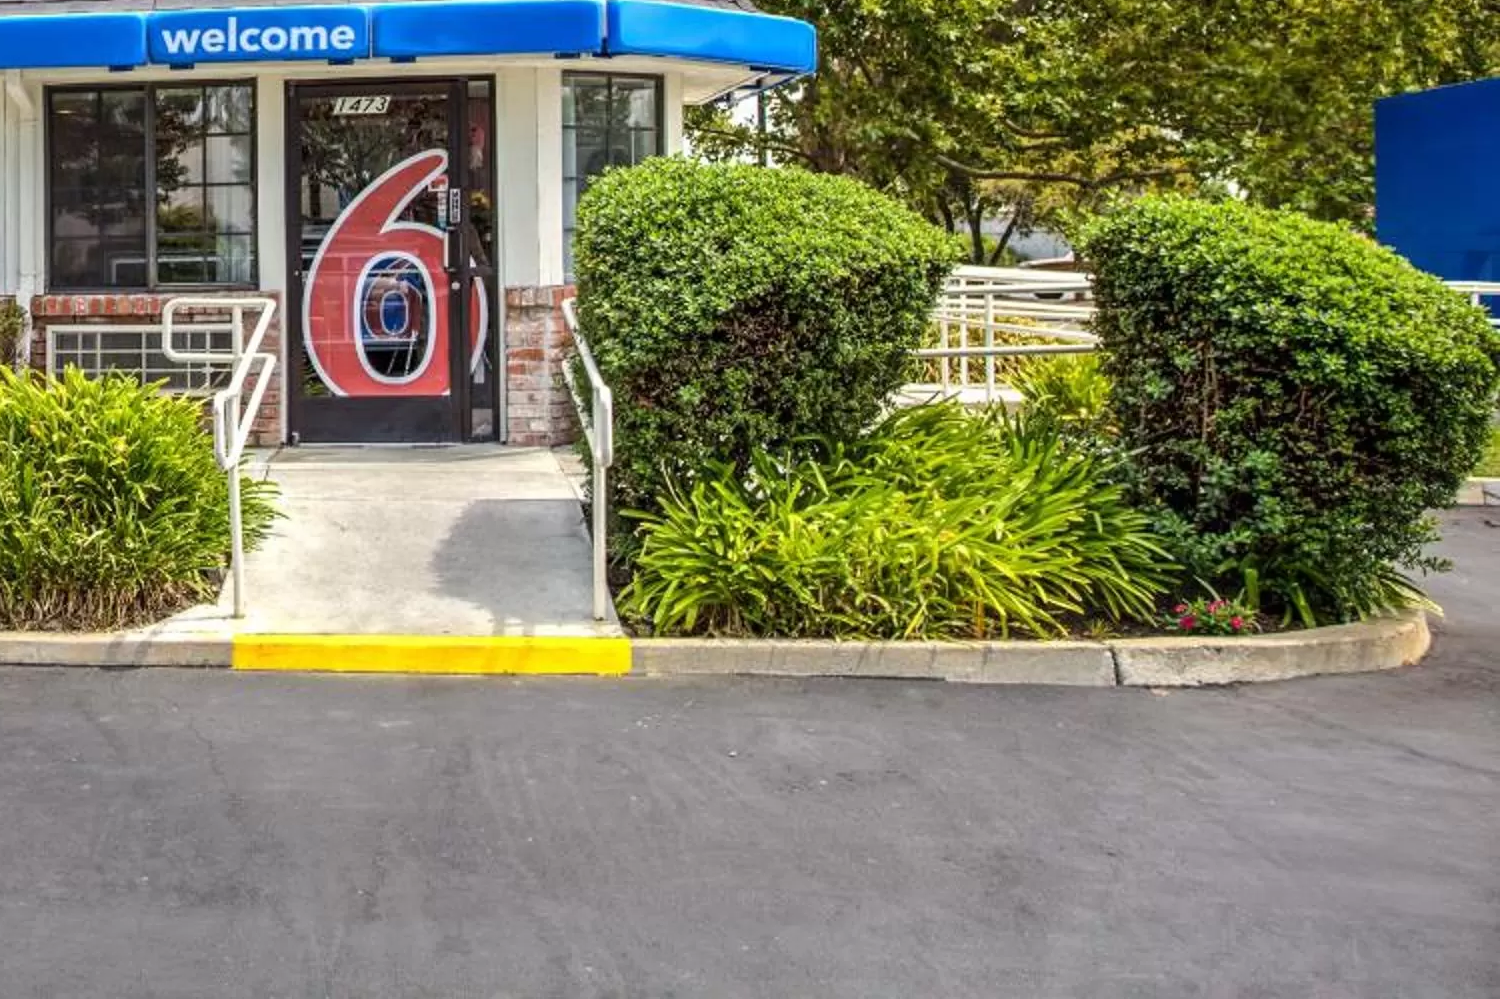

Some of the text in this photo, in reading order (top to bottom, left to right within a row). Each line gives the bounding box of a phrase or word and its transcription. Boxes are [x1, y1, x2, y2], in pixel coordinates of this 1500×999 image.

[161, 16, 356, 54] welcome
[339, 96, 387, 112] 1473
[302, 148, 488, 396] 6
